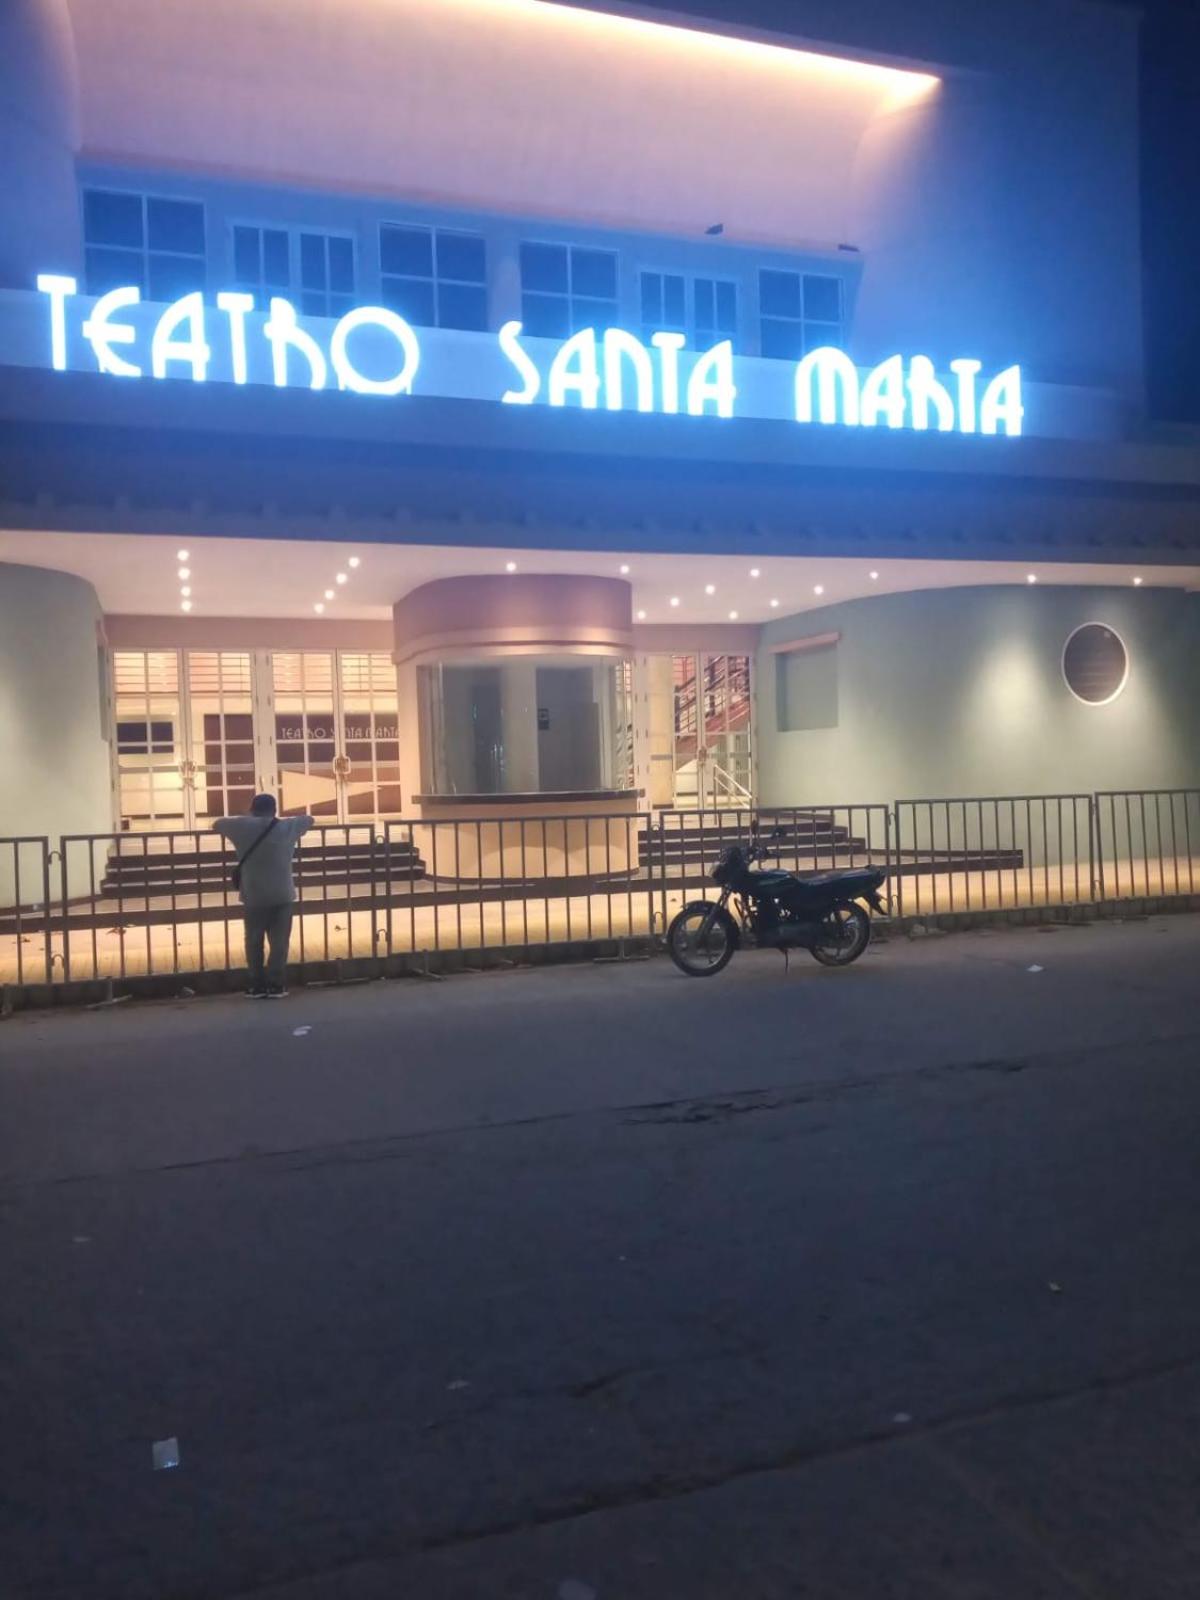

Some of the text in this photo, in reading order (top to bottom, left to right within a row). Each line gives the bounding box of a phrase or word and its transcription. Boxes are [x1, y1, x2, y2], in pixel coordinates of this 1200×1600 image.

[37, 274, 1024, 435] TEATRO SANTA MARTA
[281, 727, 327, 739] TEARO
